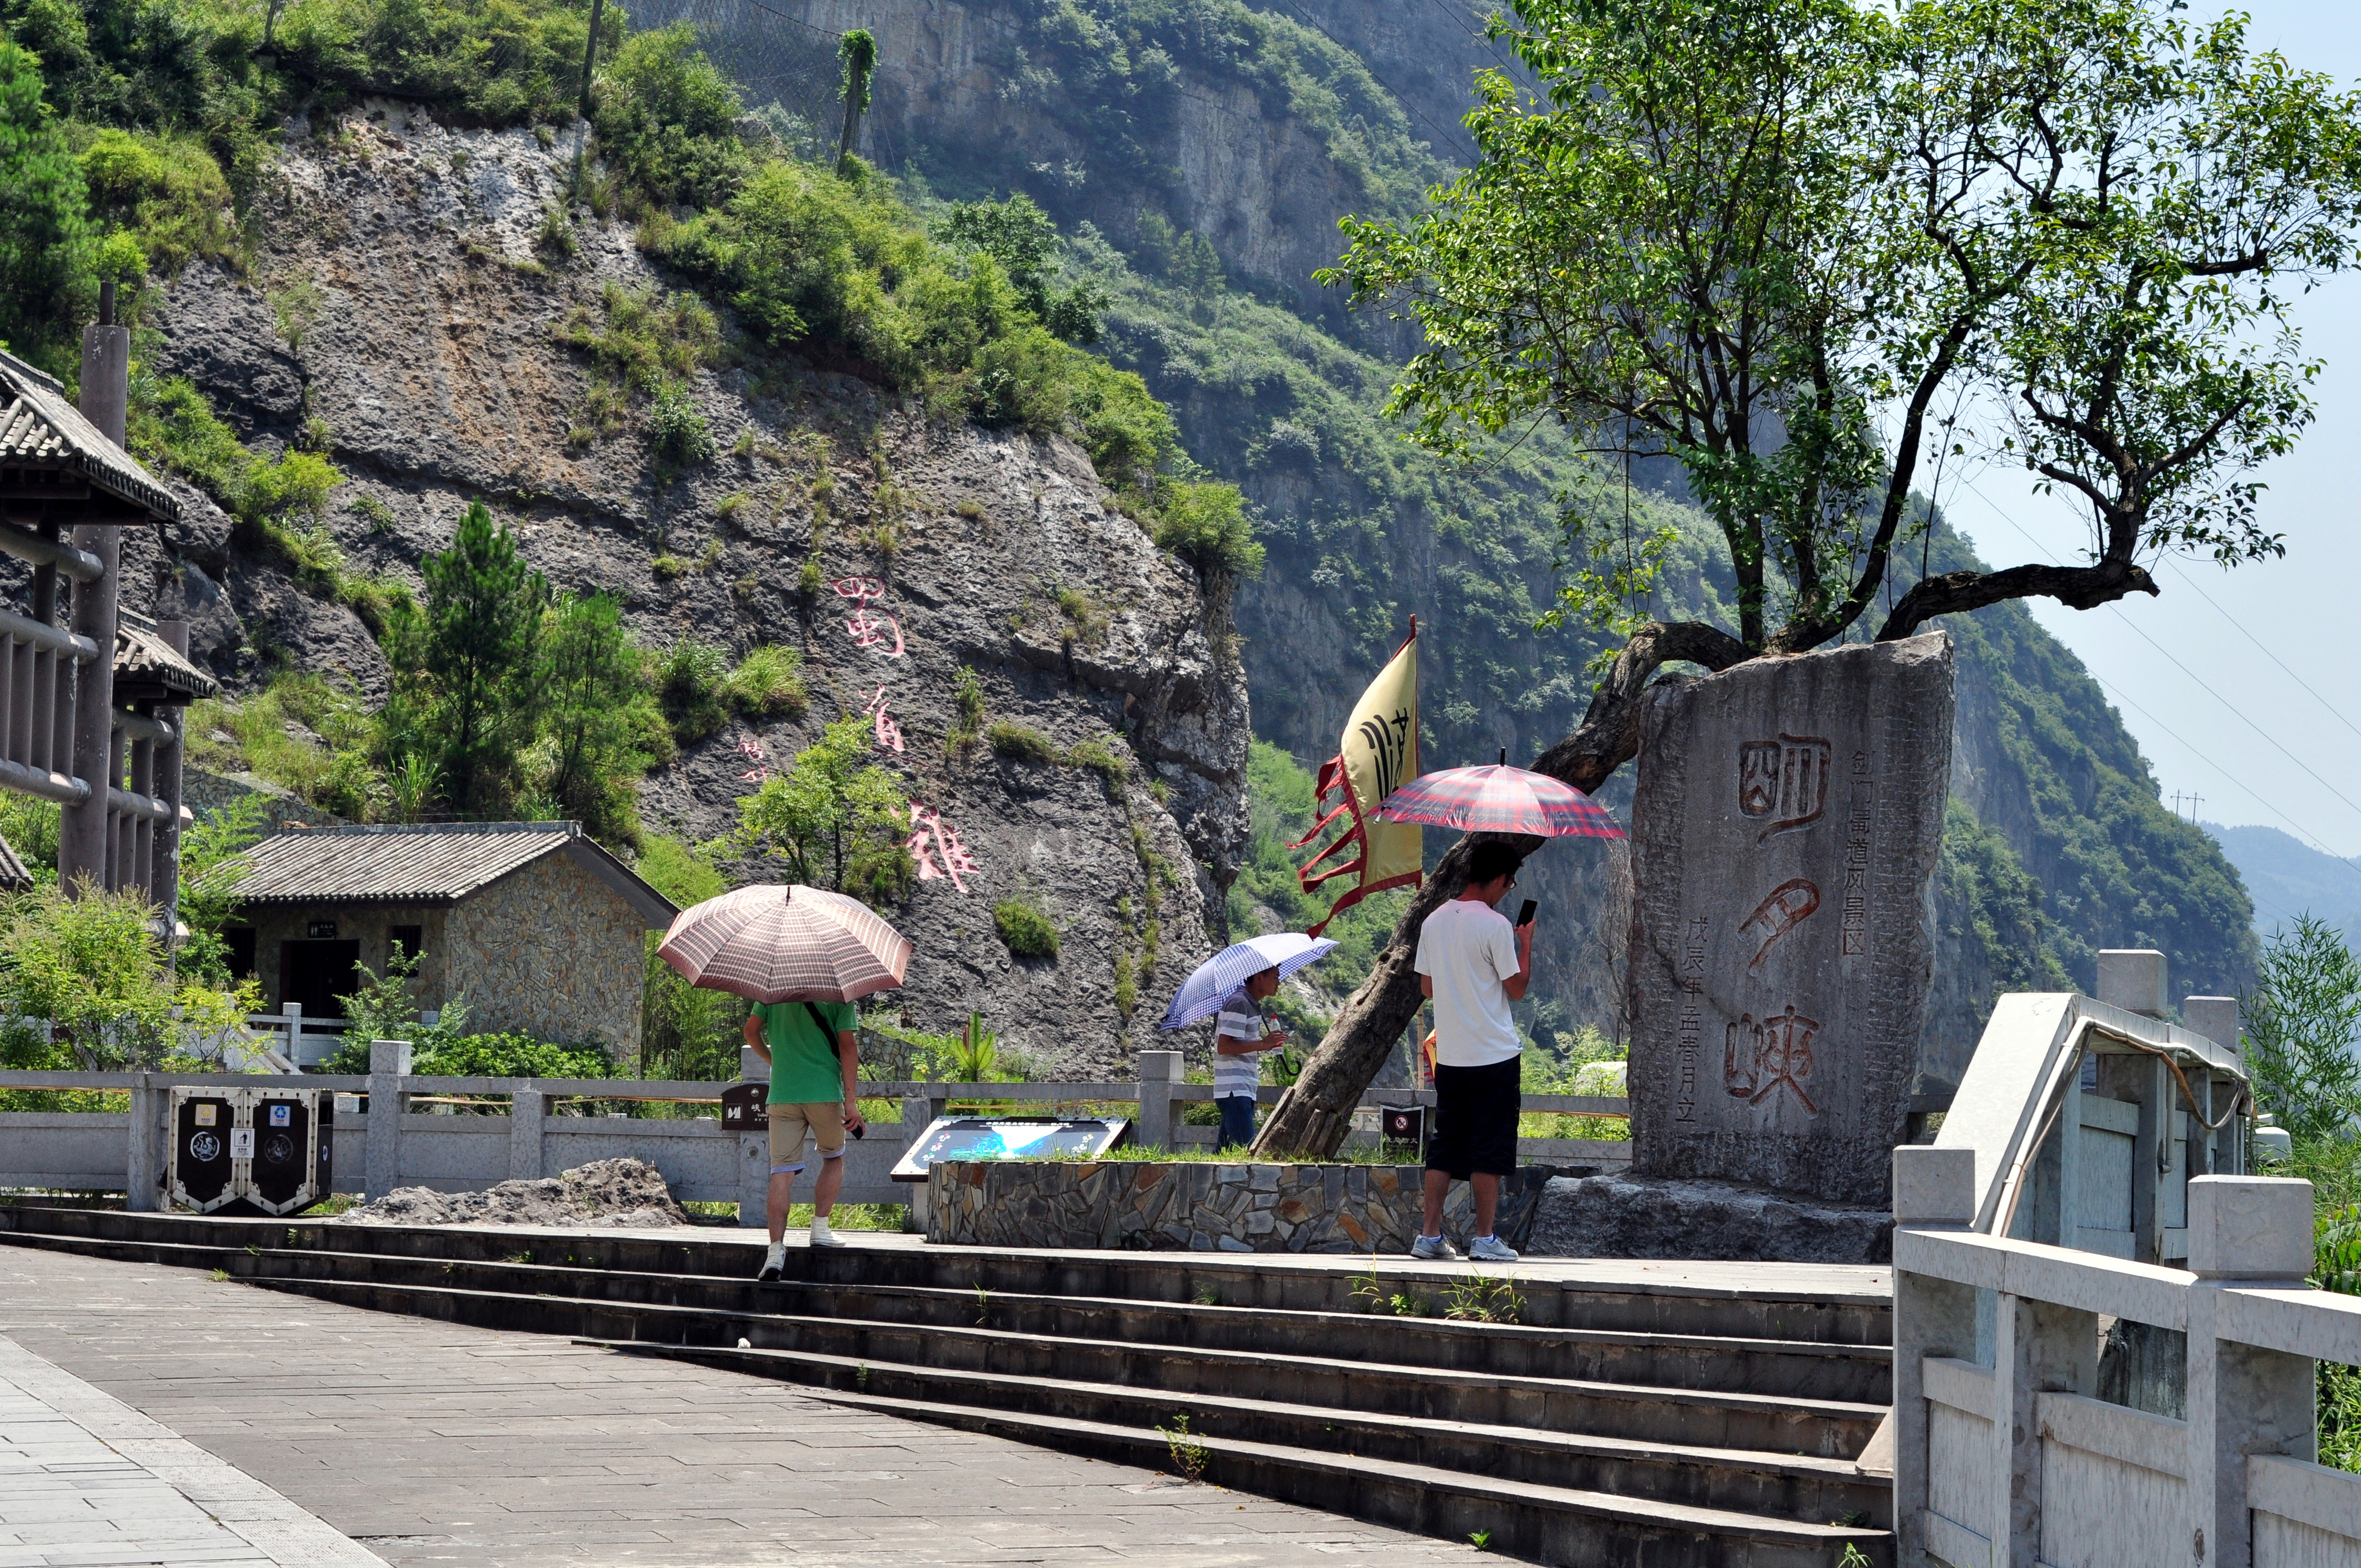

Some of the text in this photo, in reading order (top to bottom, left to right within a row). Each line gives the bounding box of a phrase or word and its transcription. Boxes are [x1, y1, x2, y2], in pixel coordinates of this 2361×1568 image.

[1842, 749, 1874, 956] 剑门蜀道风景区
[1675, 916, 1708, 1123] 戊辰年孟春月立
